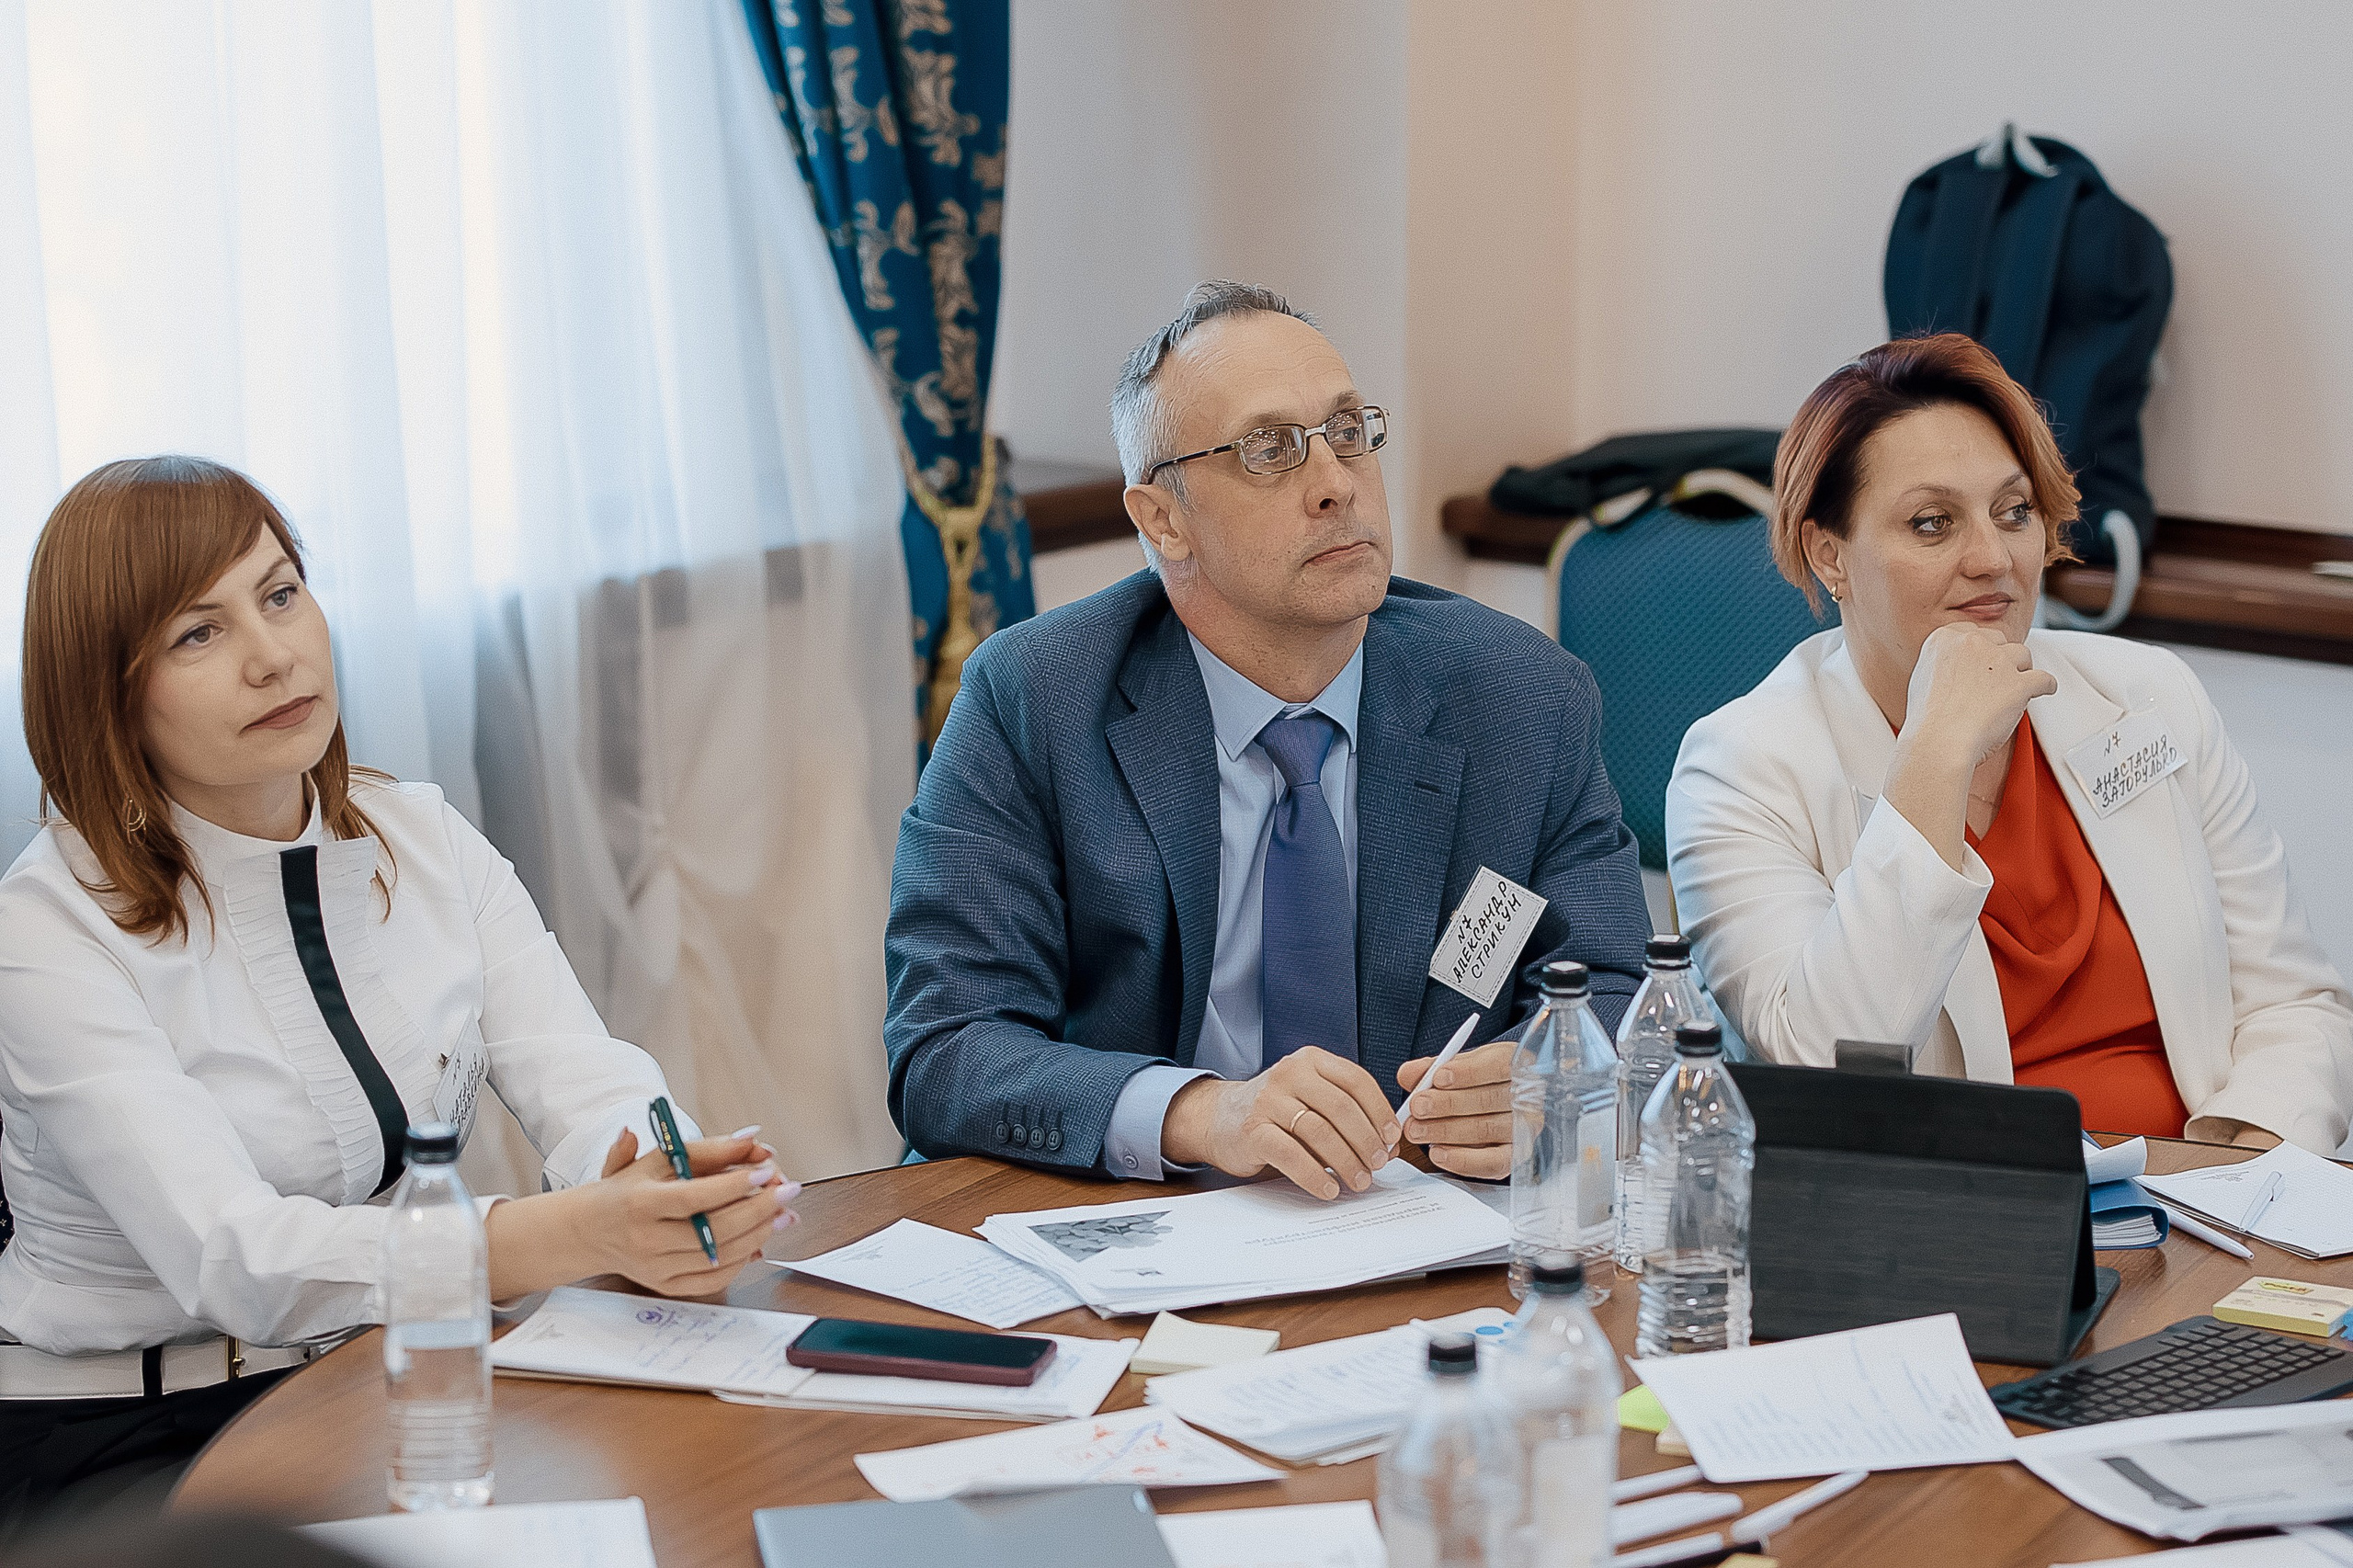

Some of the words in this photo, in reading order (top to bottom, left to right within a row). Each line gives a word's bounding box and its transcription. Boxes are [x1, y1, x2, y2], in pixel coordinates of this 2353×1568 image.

[2093, 734, 2167, 795] АНАСТАСИЯ
[1452, 881, 1507, 983] АЛЕКСАНДР
[1472, 893, 1521, 979] СТРИКУН
